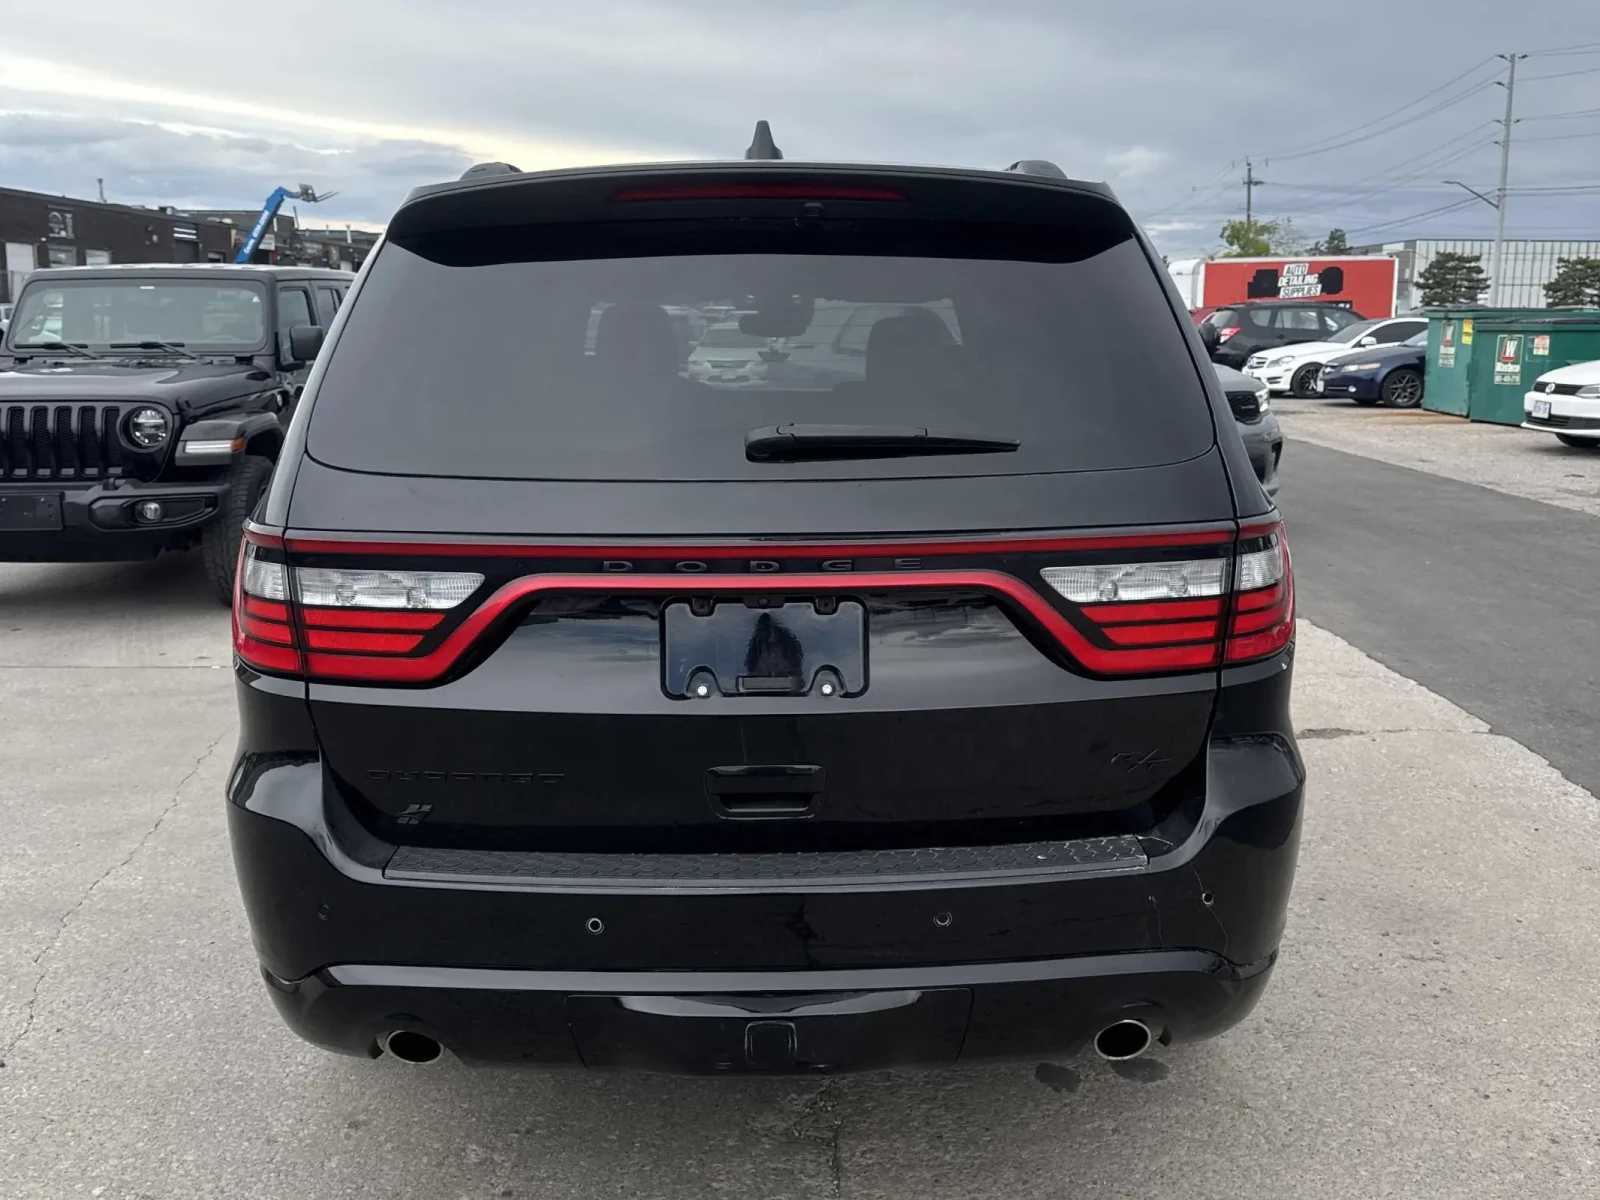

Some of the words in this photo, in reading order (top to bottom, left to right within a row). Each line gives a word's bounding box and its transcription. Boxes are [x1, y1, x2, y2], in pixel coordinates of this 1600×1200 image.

[1284, 264, 1307, 275] AUTO
[1278, 273, 1319, 287] DETAILING
[1281, 286, 1319, 298] SUPPLIES
[602, 558, 923, 573] DODGE
